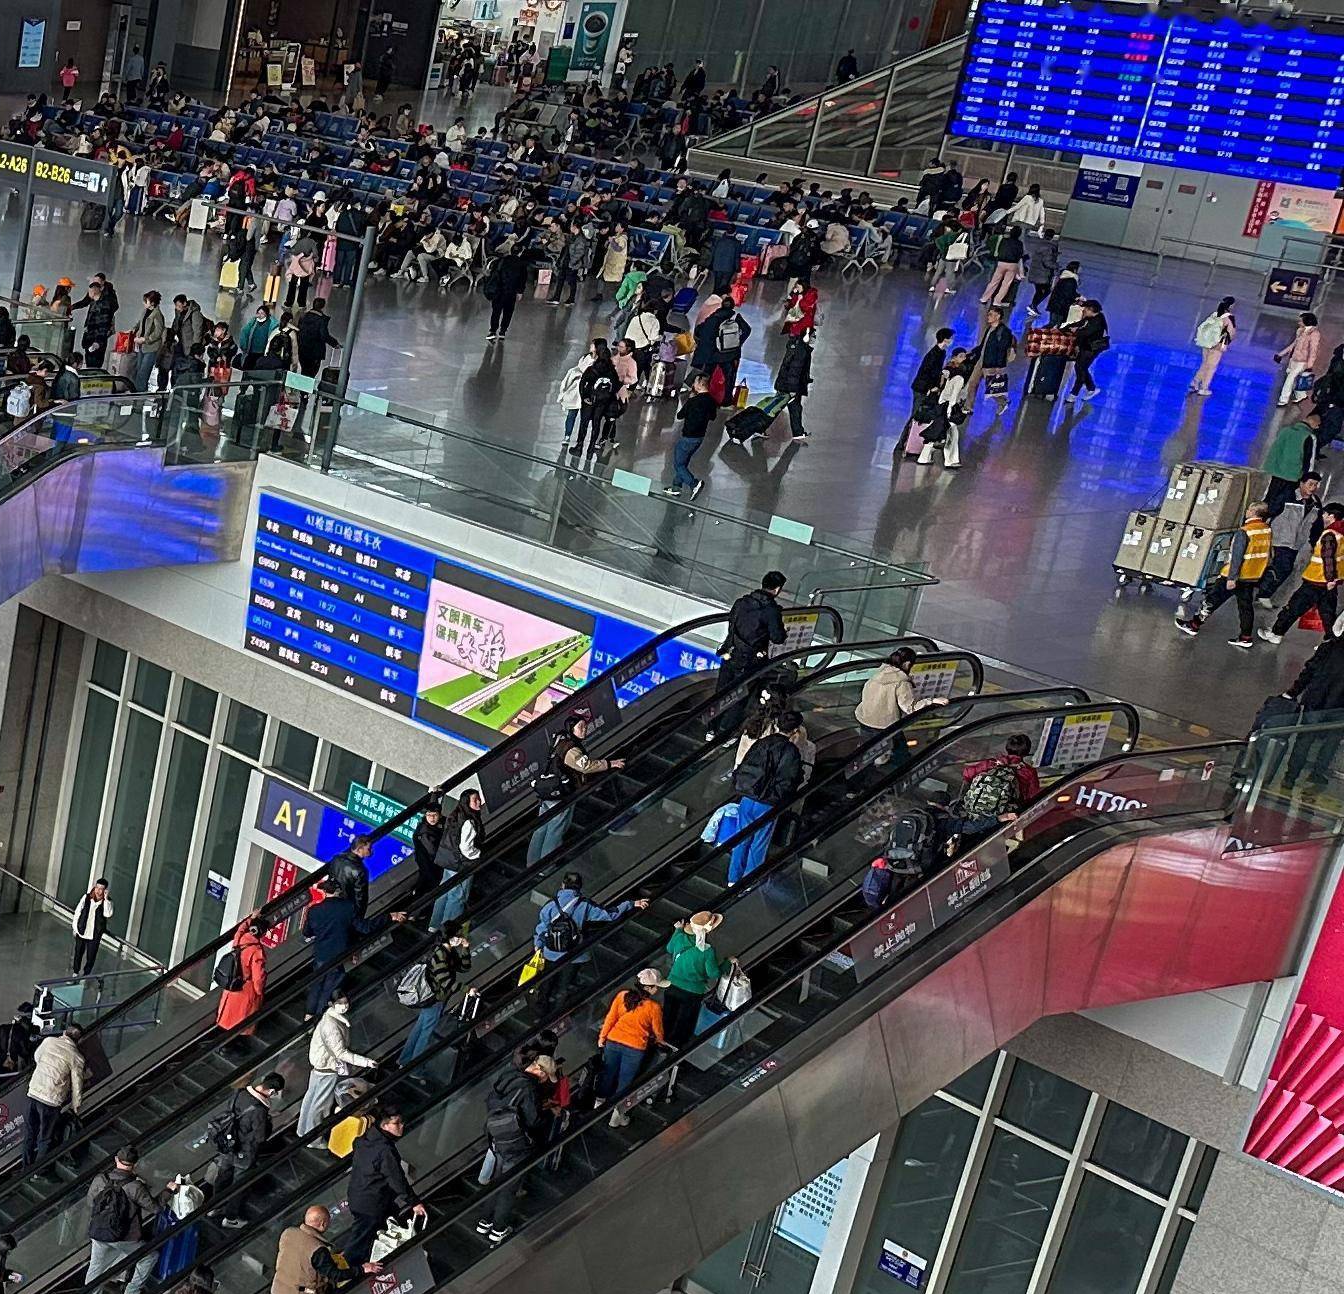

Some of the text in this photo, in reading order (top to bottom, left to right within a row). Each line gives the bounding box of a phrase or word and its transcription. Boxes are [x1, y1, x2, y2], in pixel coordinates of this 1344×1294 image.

[35, 161, 70, 183] B2-B26
[273, 800, 308, 838] A1
[947, 867, 992, 907] 禁止翻越
